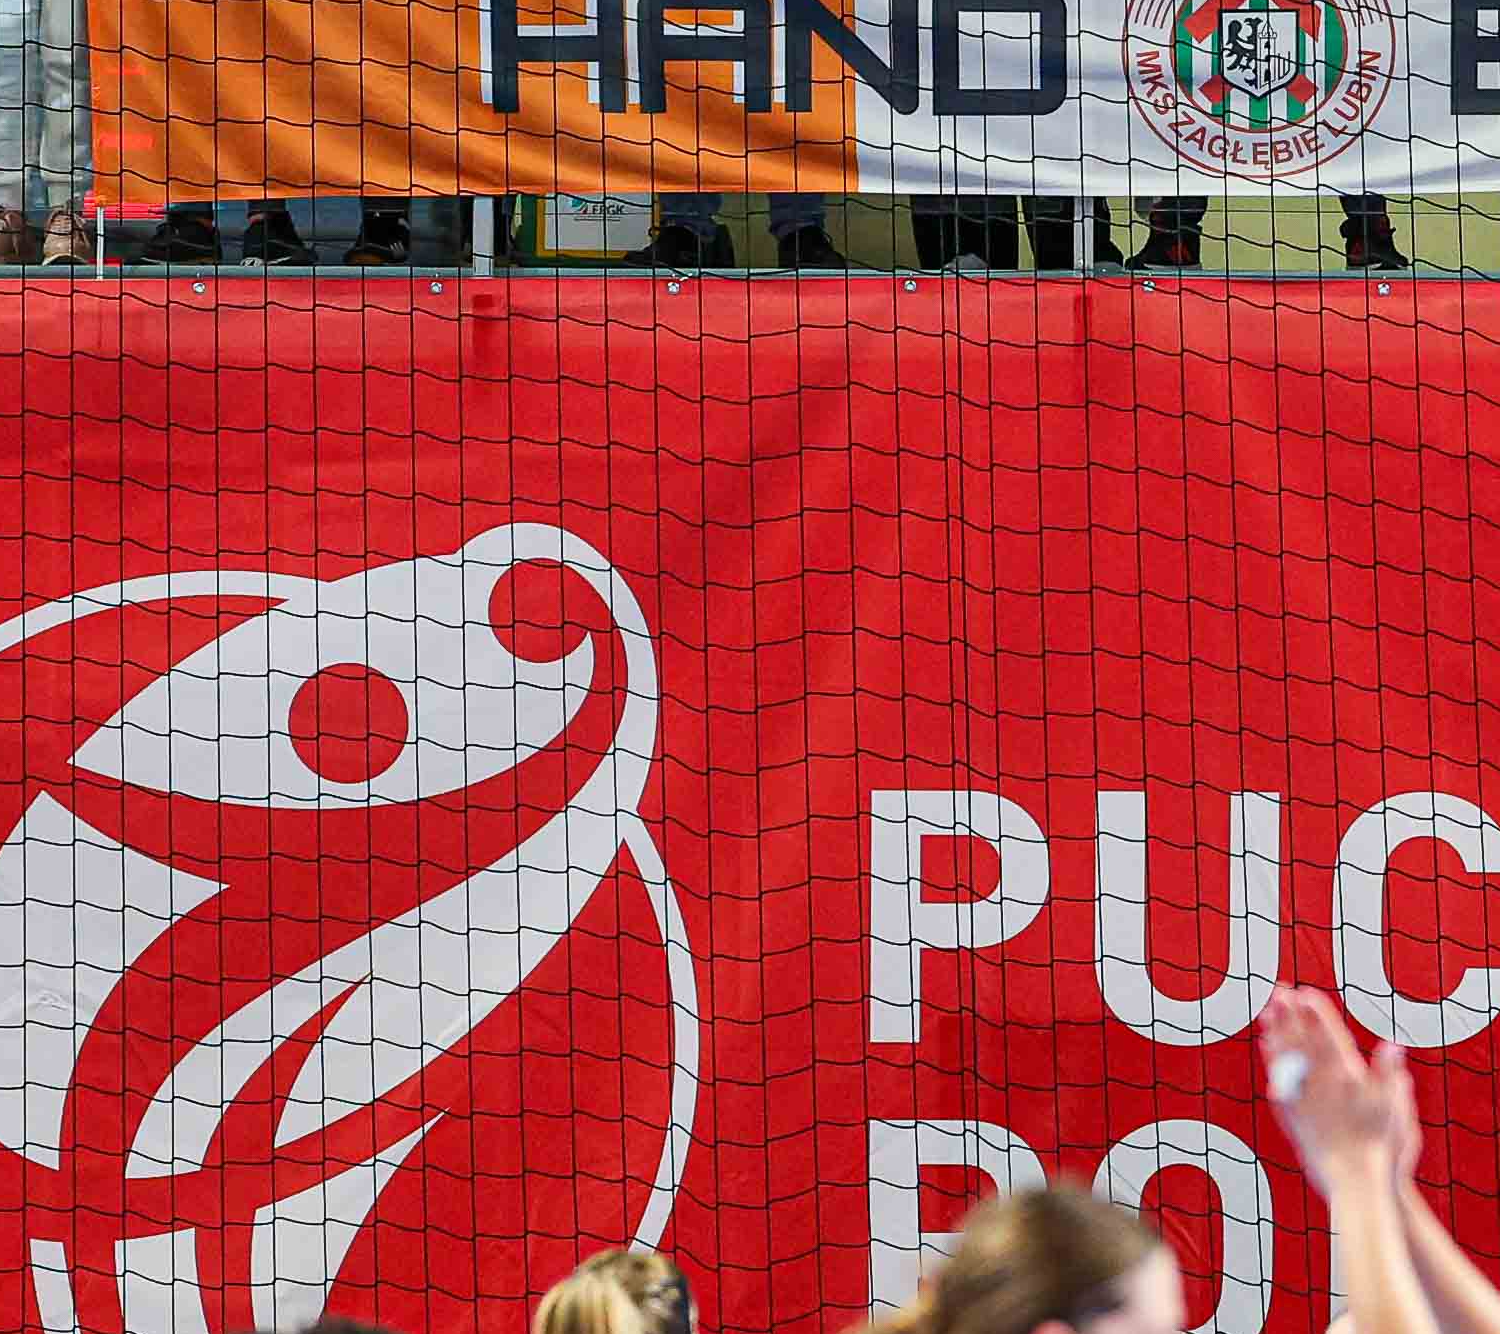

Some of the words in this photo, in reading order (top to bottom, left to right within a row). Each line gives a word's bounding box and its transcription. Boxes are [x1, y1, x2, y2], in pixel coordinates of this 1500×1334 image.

[1136, 50, 1177, 116] MKS
[1168, 109, 1327, 172] ZAGŁĘBIE
[1321, 49, 1382, 139] LUBIN
